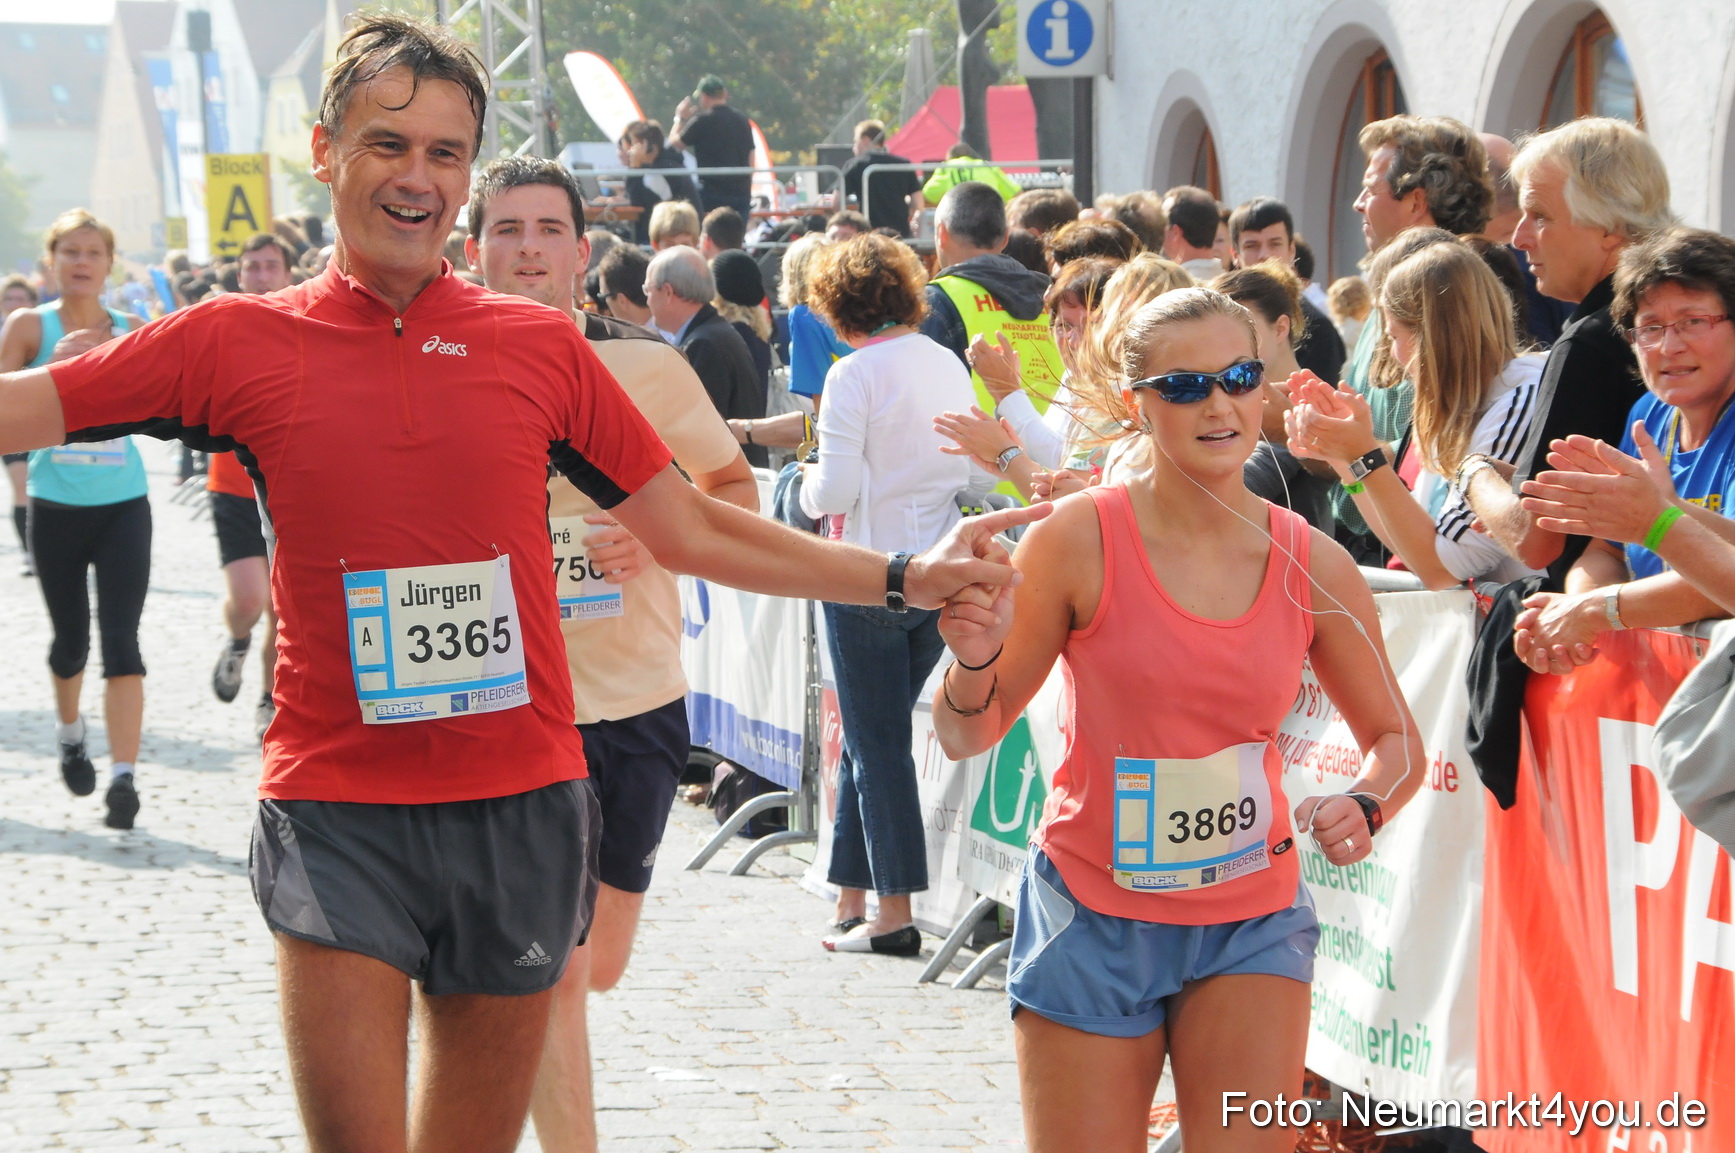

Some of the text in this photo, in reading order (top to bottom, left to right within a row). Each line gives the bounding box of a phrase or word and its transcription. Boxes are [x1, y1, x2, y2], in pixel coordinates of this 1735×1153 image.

[210, 157, 263, 175] Block
[223, 184, 259, 231] A
[401, 580, 482, 610] Jürgen
[572, 600, 621, 613] PFLEIDERER
[362, 627, 373, 647] A
[407, 615, 511, 663] 3365
[471, 682, 526, 702] PFLEIDERER
[376, 701, 424, 716] BOCK
[471, 695, 528, 711] AKTIENGESELLSCHAFT
[1168, 797, 1257, 844] 3869
[1218, 848, 1265, 875] PFLEIDERER
[1132, 875, 1177, 886] BOCK
[514, 955, 552, 967] adidas
